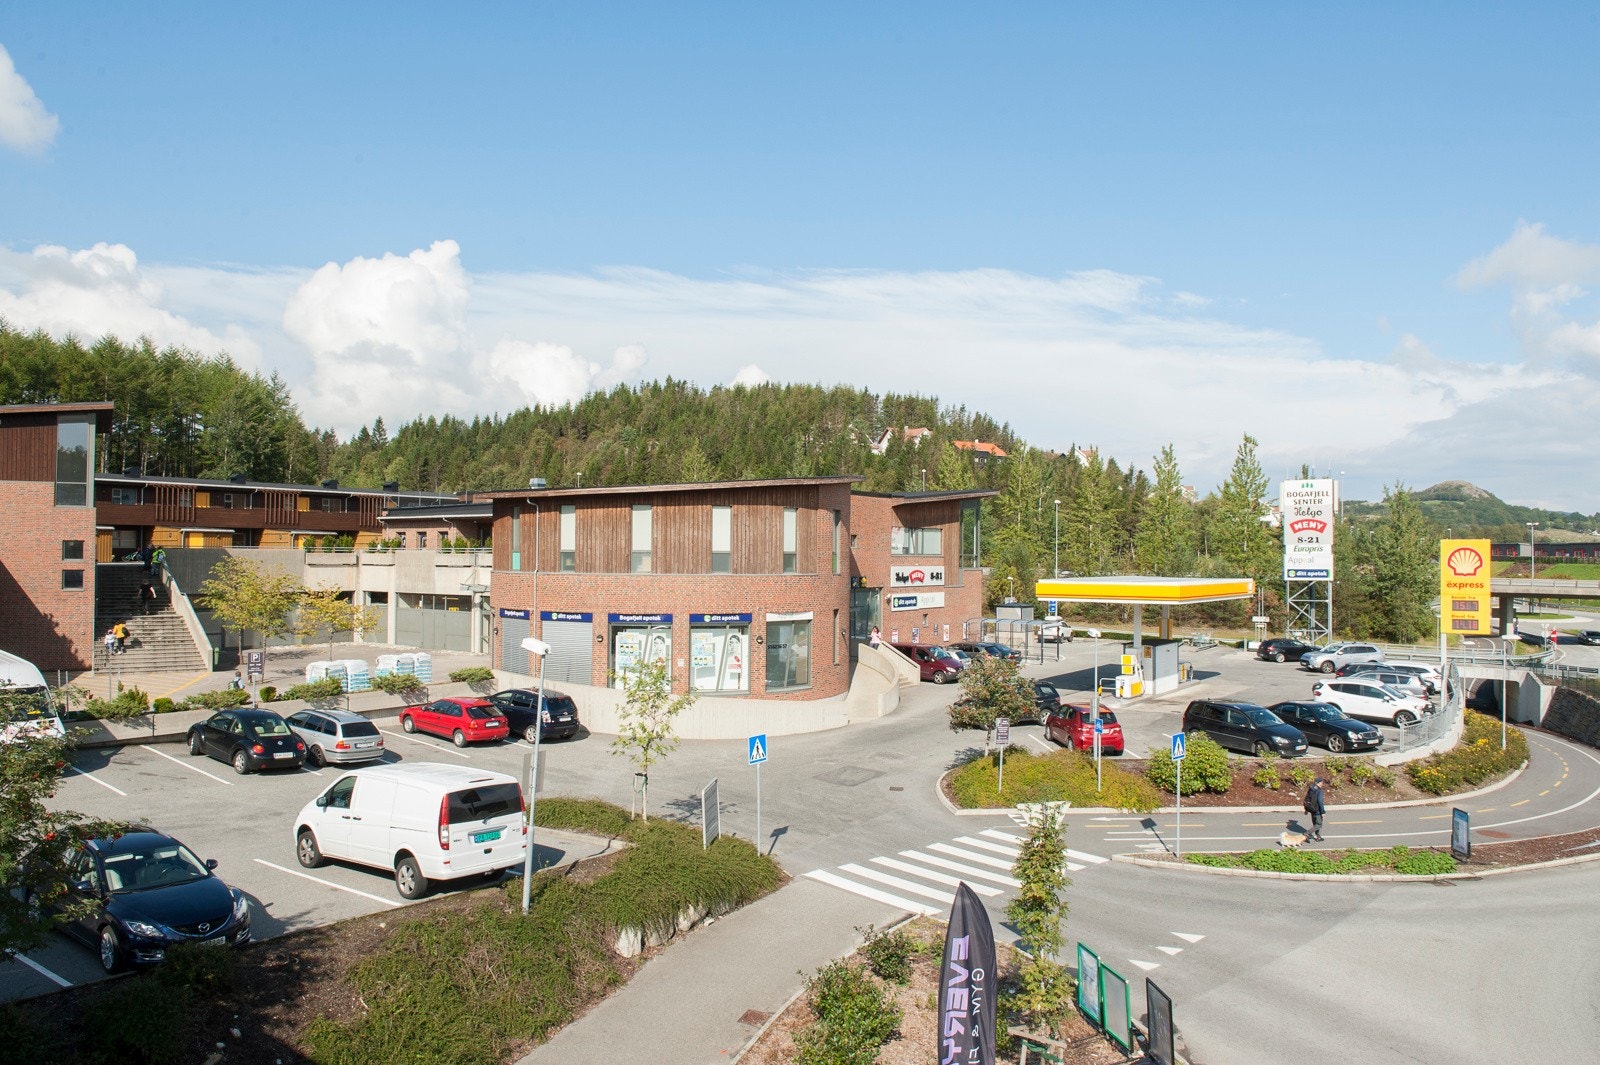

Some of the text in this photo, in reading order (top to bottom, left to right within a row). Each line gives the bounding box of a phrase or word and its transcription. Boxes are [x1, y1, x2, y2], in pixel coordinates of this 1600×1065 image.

[1294, 507, 1323, 518] Helgo
[1293, 521, 1323, 530] MENY
[1293, 545, 1324, 553] Europris
[1447, 581, 1484, 590] express
[721, 614, 740, 622] apotek
